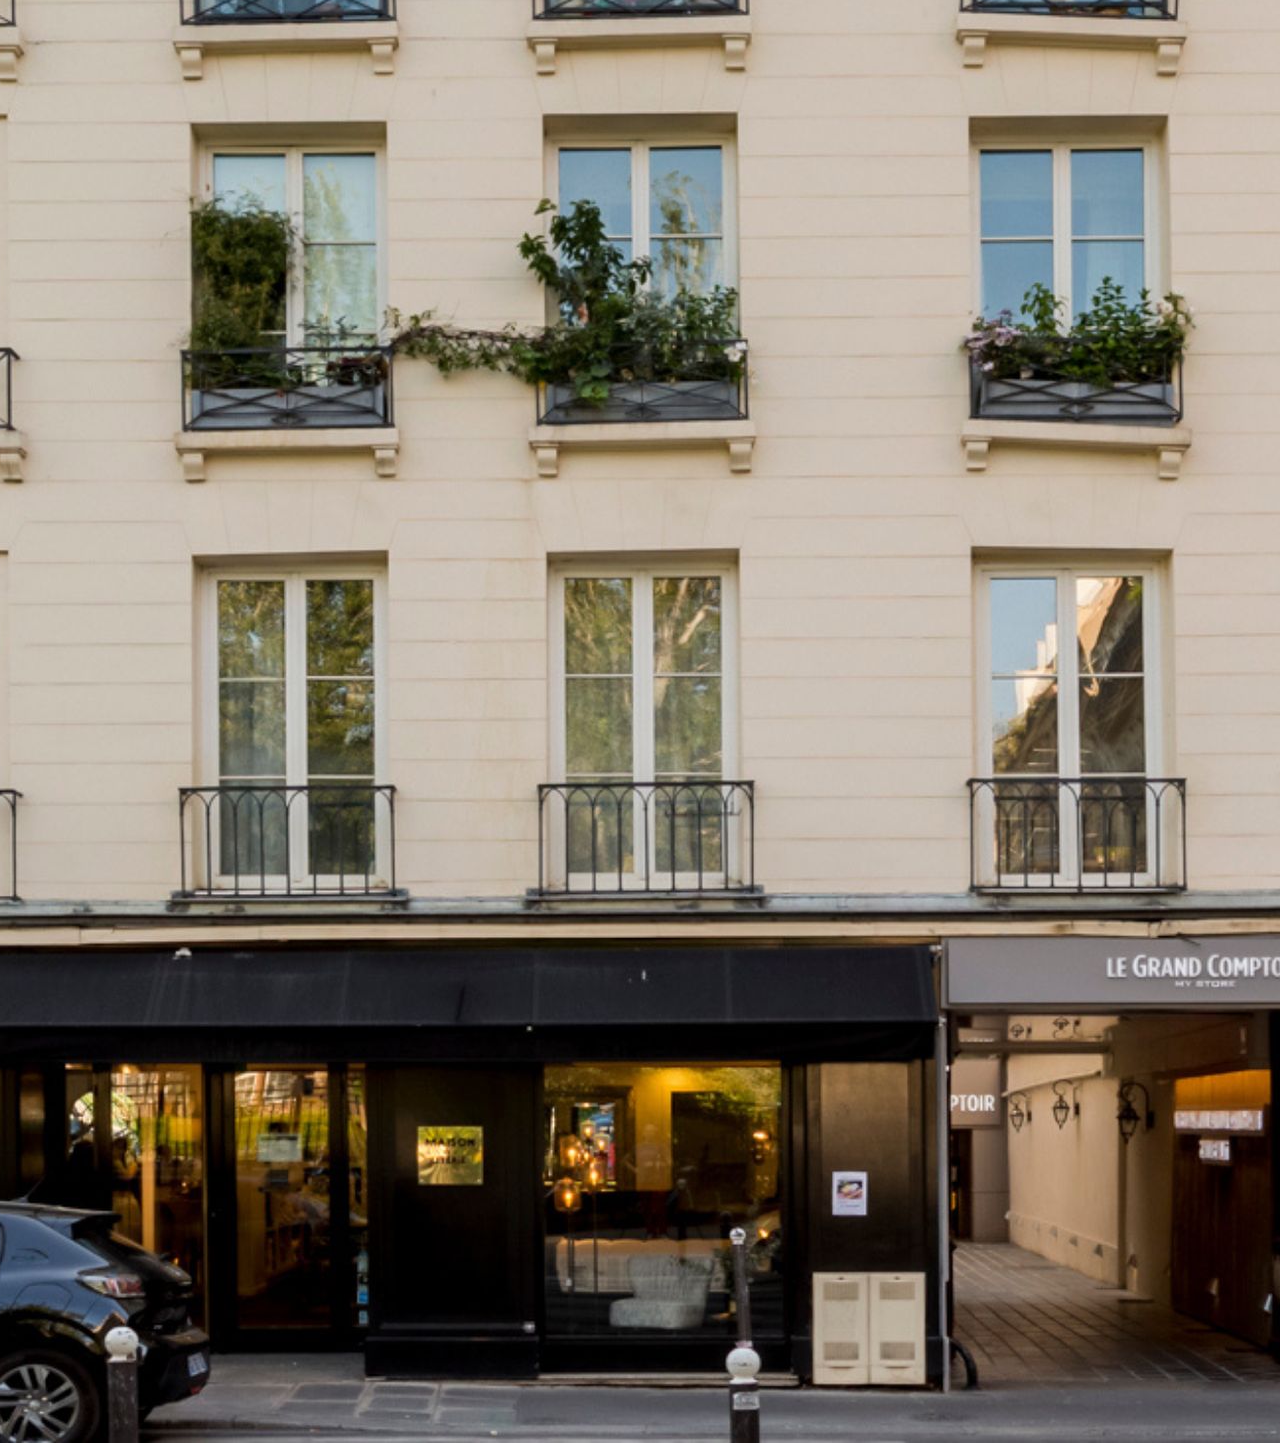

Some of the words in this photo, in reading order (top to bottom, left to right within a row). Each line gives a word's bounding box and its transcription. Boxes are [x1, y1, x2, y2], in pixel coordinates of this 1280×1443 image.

[1107, 957, 1127, 977] LE
[1132, 954, 1202, 978] GRAND
[1195, 980, 1235, 988] STORE
